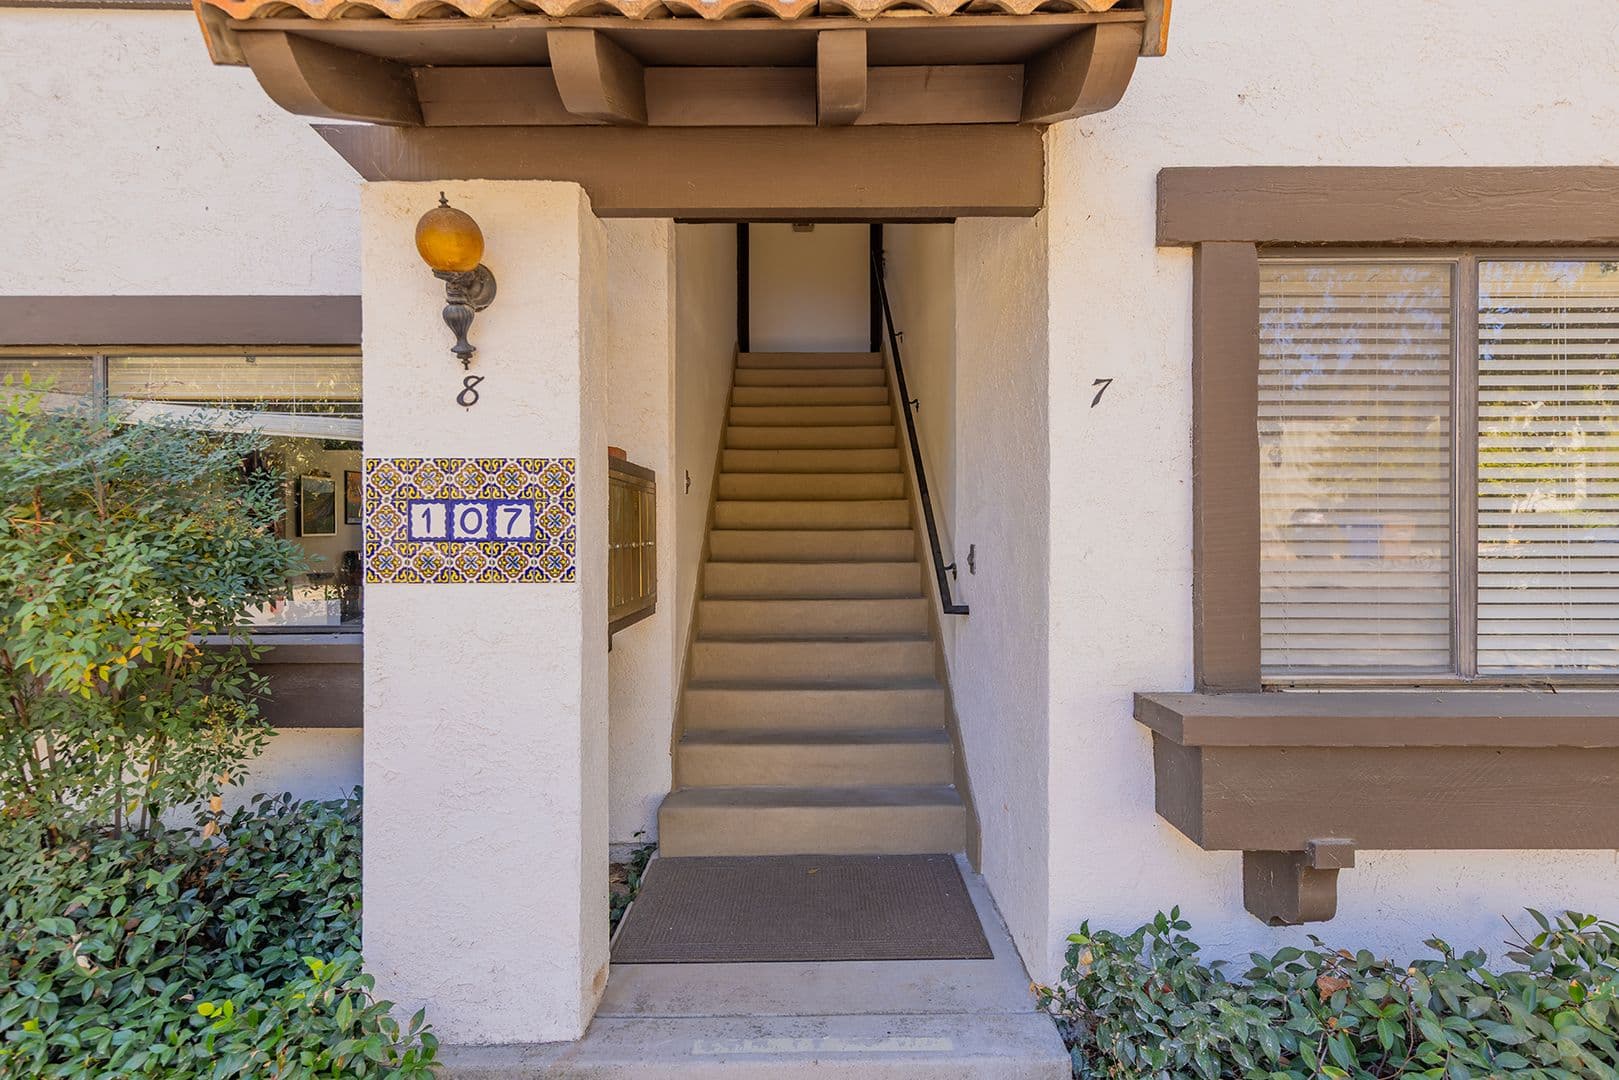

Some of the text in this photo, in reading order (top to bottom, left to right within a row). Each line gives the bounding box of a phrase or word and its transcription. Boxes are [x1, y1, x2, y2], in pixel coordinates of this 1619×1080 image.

[456, 375, 485, 407] 8
[1090, 378, 1114, 409] 7
[421, 507, 523, 536] 107
